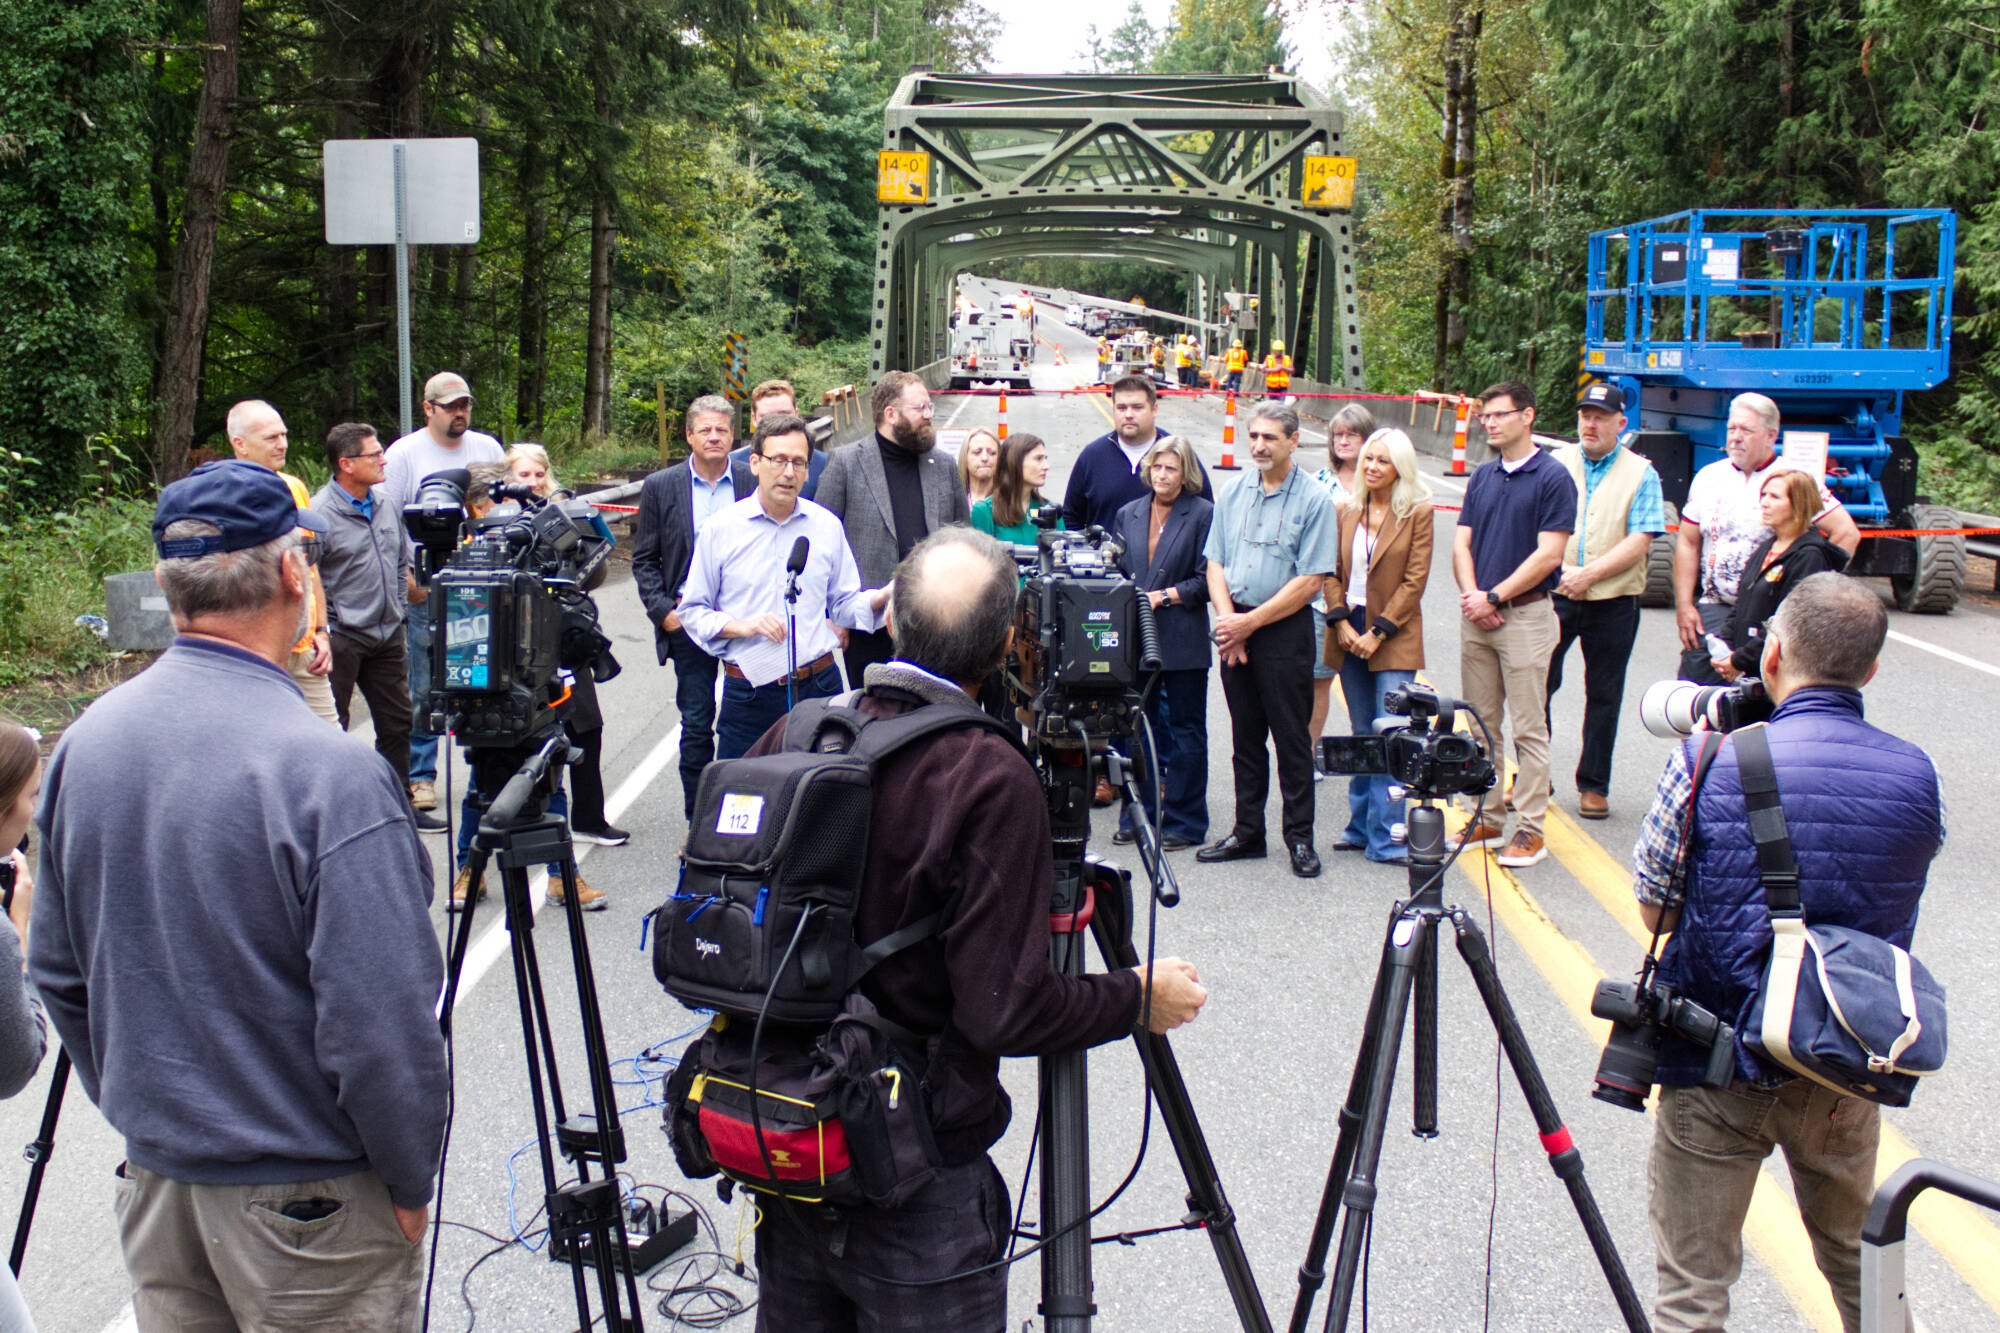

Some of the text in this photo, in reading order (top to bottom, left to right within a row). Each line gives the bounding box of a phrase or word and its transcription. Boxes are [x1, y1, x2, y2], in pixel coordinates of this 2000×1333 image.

[446, 613, 489, 646] 150
[730, 814, 750, 830] 112
[695, 937, 721, 960] Dejero
